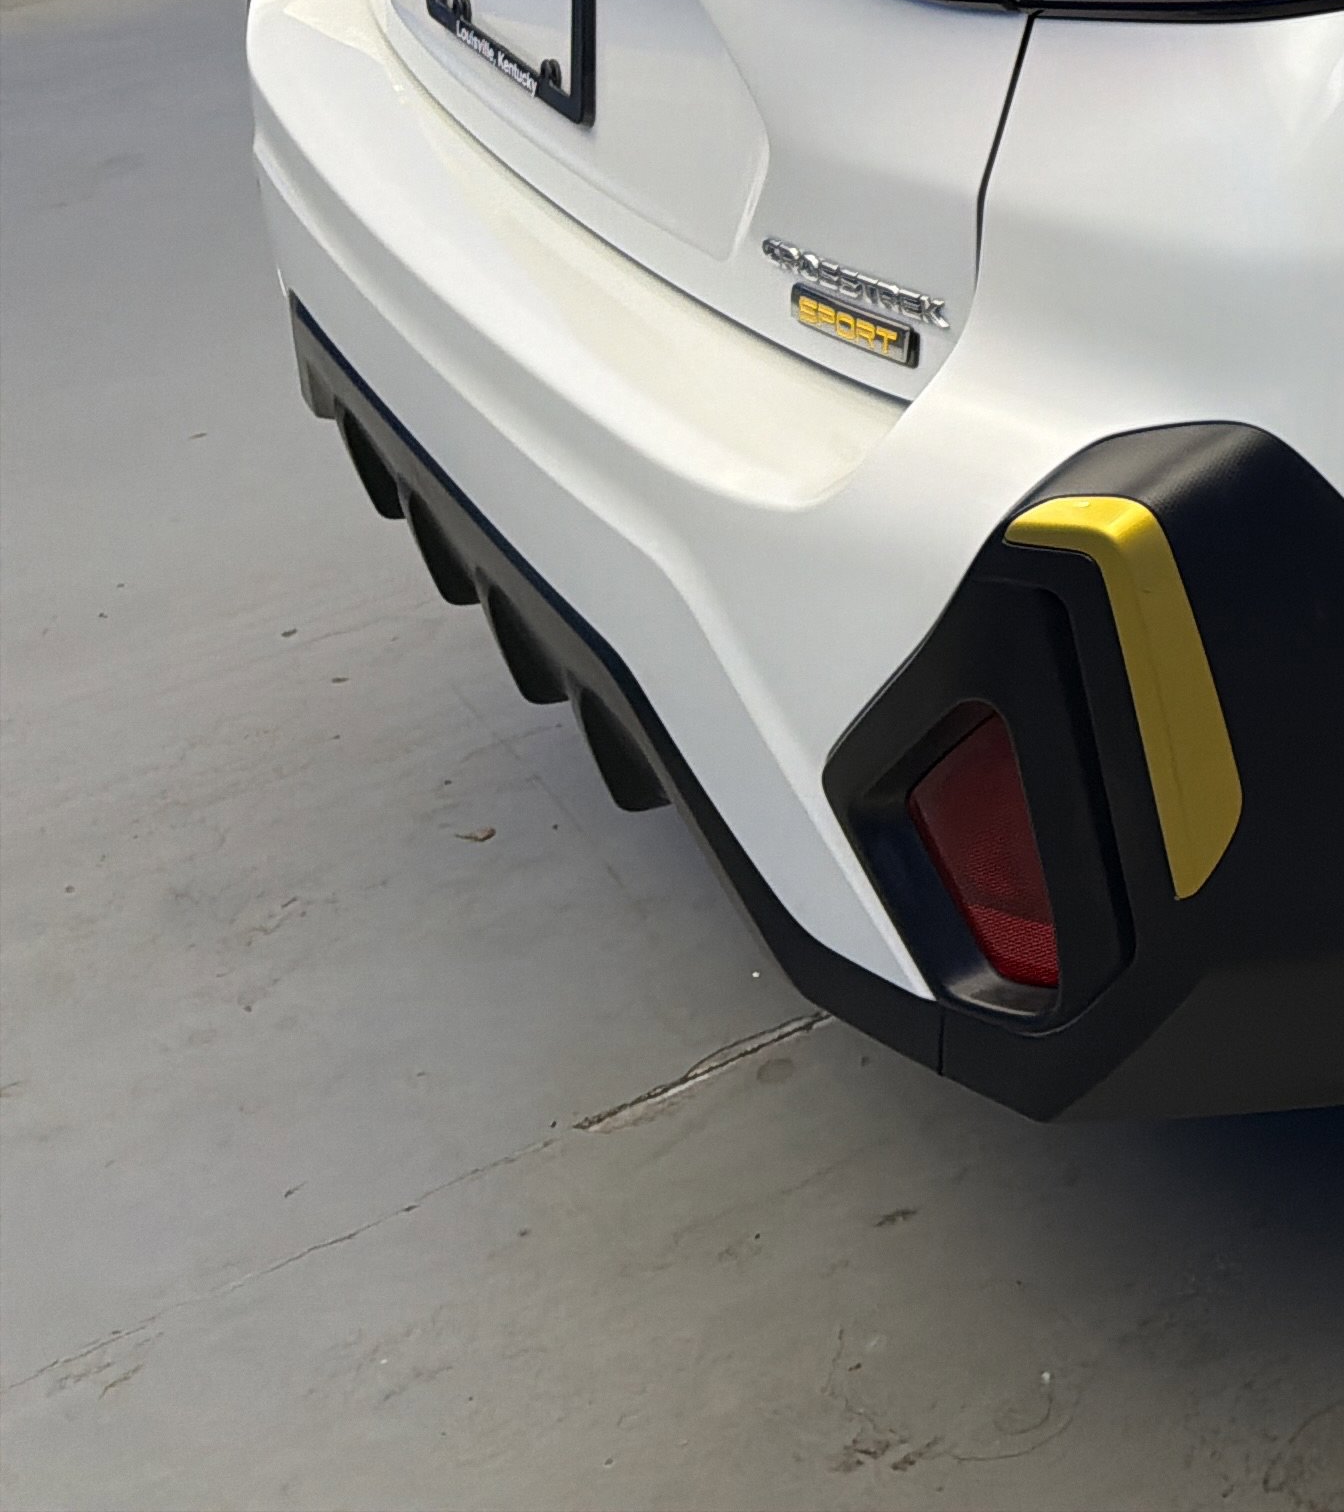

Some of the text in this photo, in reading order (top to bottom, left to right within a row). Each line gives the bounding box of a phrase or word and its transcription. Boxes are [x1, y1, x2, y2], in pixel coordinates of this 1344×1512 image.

[455, 20, 538, 98] Louisville, Kentucky
[762, 238, 949, 328] CROSSTREK
[799, 295, 897, 354] SPORT
